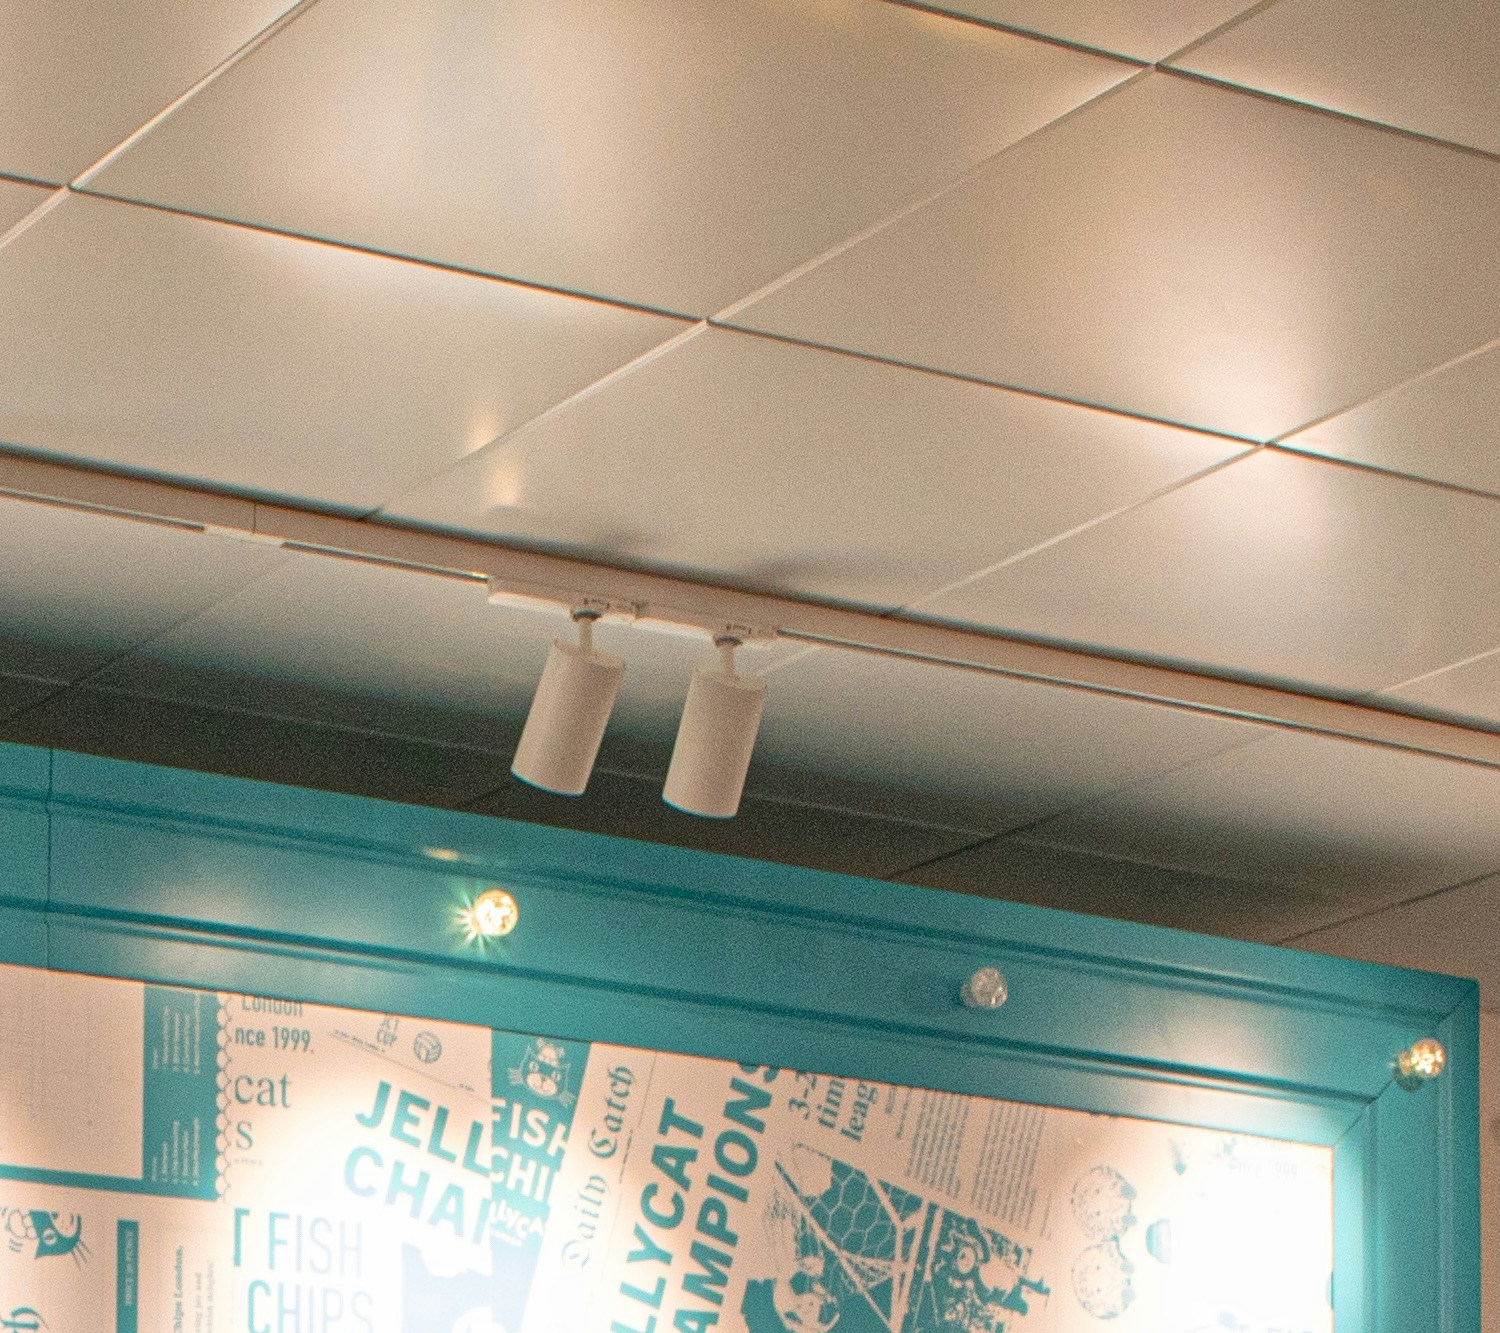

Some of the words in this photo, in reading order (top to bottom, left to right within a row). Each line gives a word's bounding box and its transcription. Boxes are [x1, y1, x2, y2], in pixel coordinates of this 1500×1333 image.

[273, 1026, 316, 1055] 1999.
[233, 1072, 292, 1109] cat
[588, 1063, 635, 1159] Catch
[268, 1210, 363, 1279] FISH
